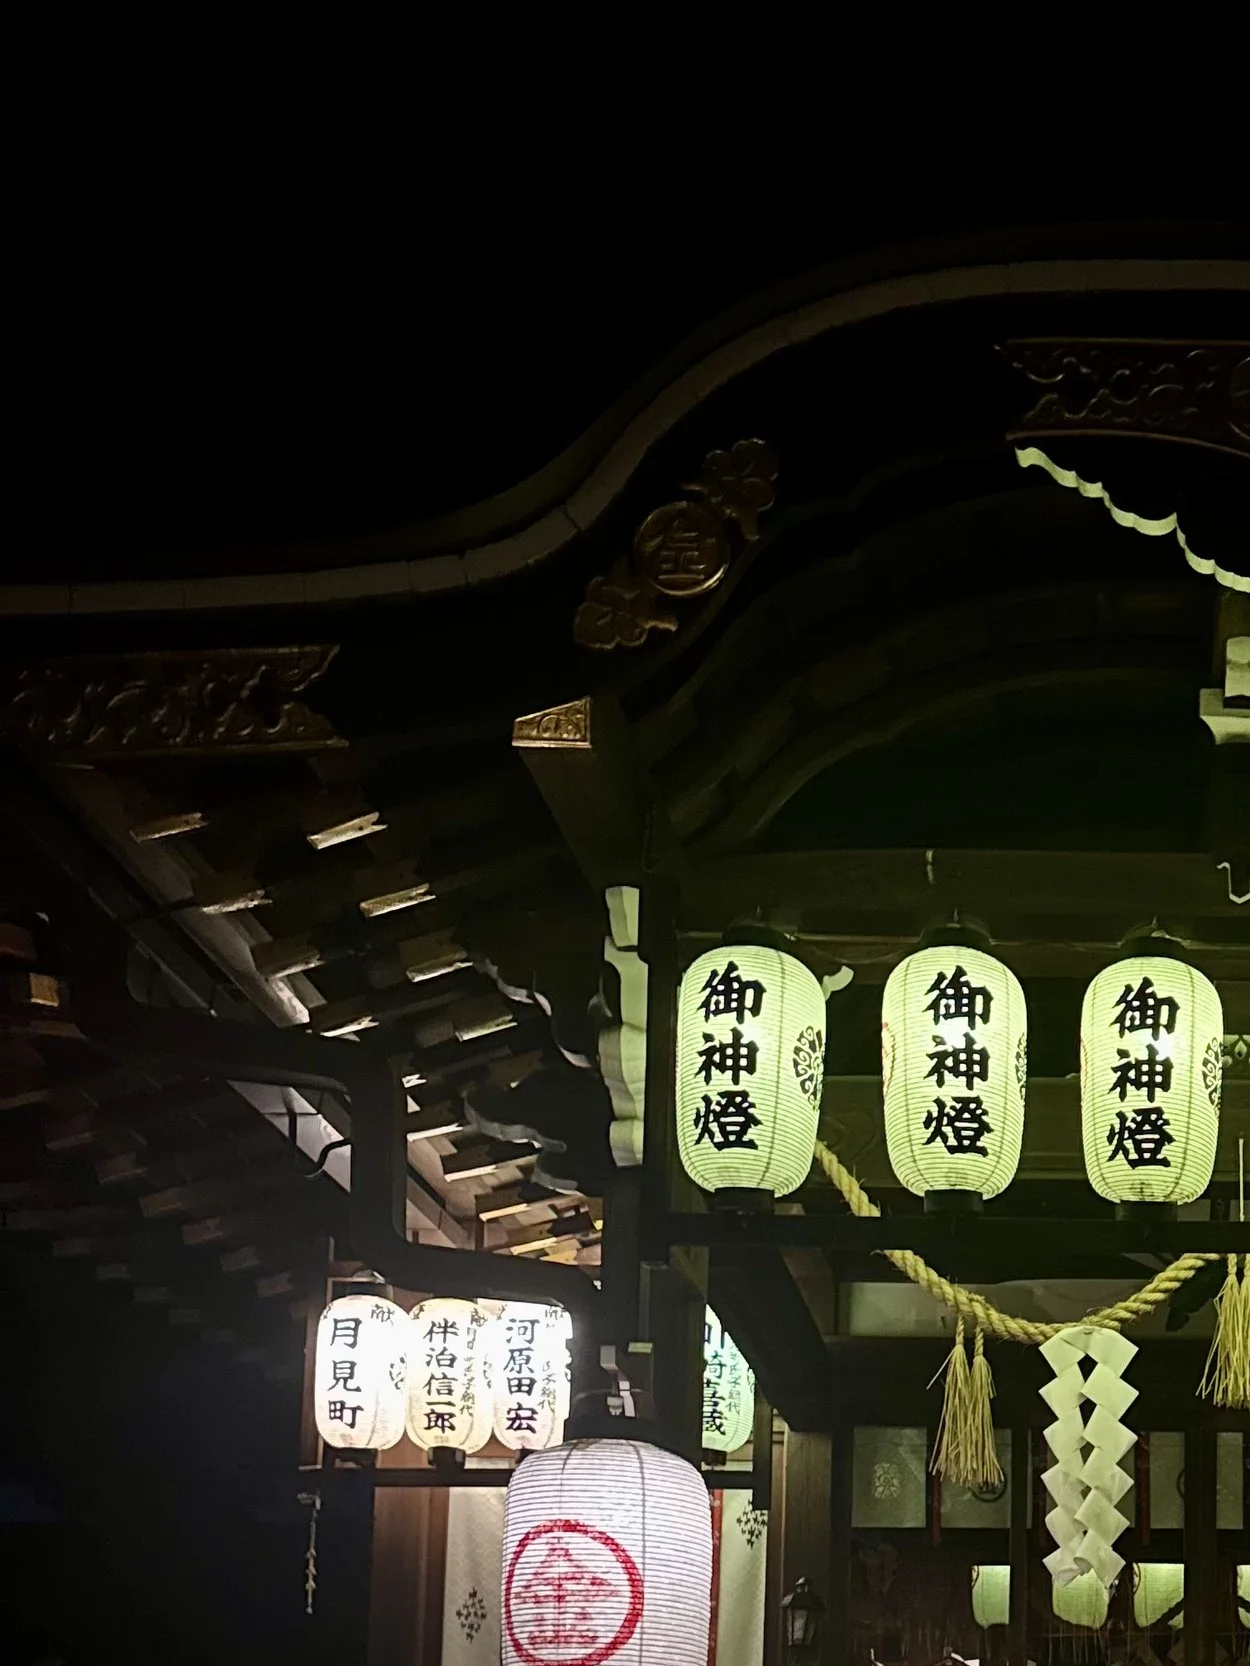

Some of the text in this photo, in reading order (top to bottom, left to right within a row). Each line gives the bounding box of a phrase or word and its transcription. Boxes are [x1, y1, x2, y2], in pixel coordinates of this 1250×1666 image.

[694, 960, 767, 1152] 御神燈
[922, 964, 994, 1158] 御神燈
[1106, 975, 1180, 1170] 御神燈
[327, 1317, 364, 1430] 月見町
[422, 1318, 460, 1434] 伴治信一郎
[503, 1318, 541, 1434] 河原田宏
